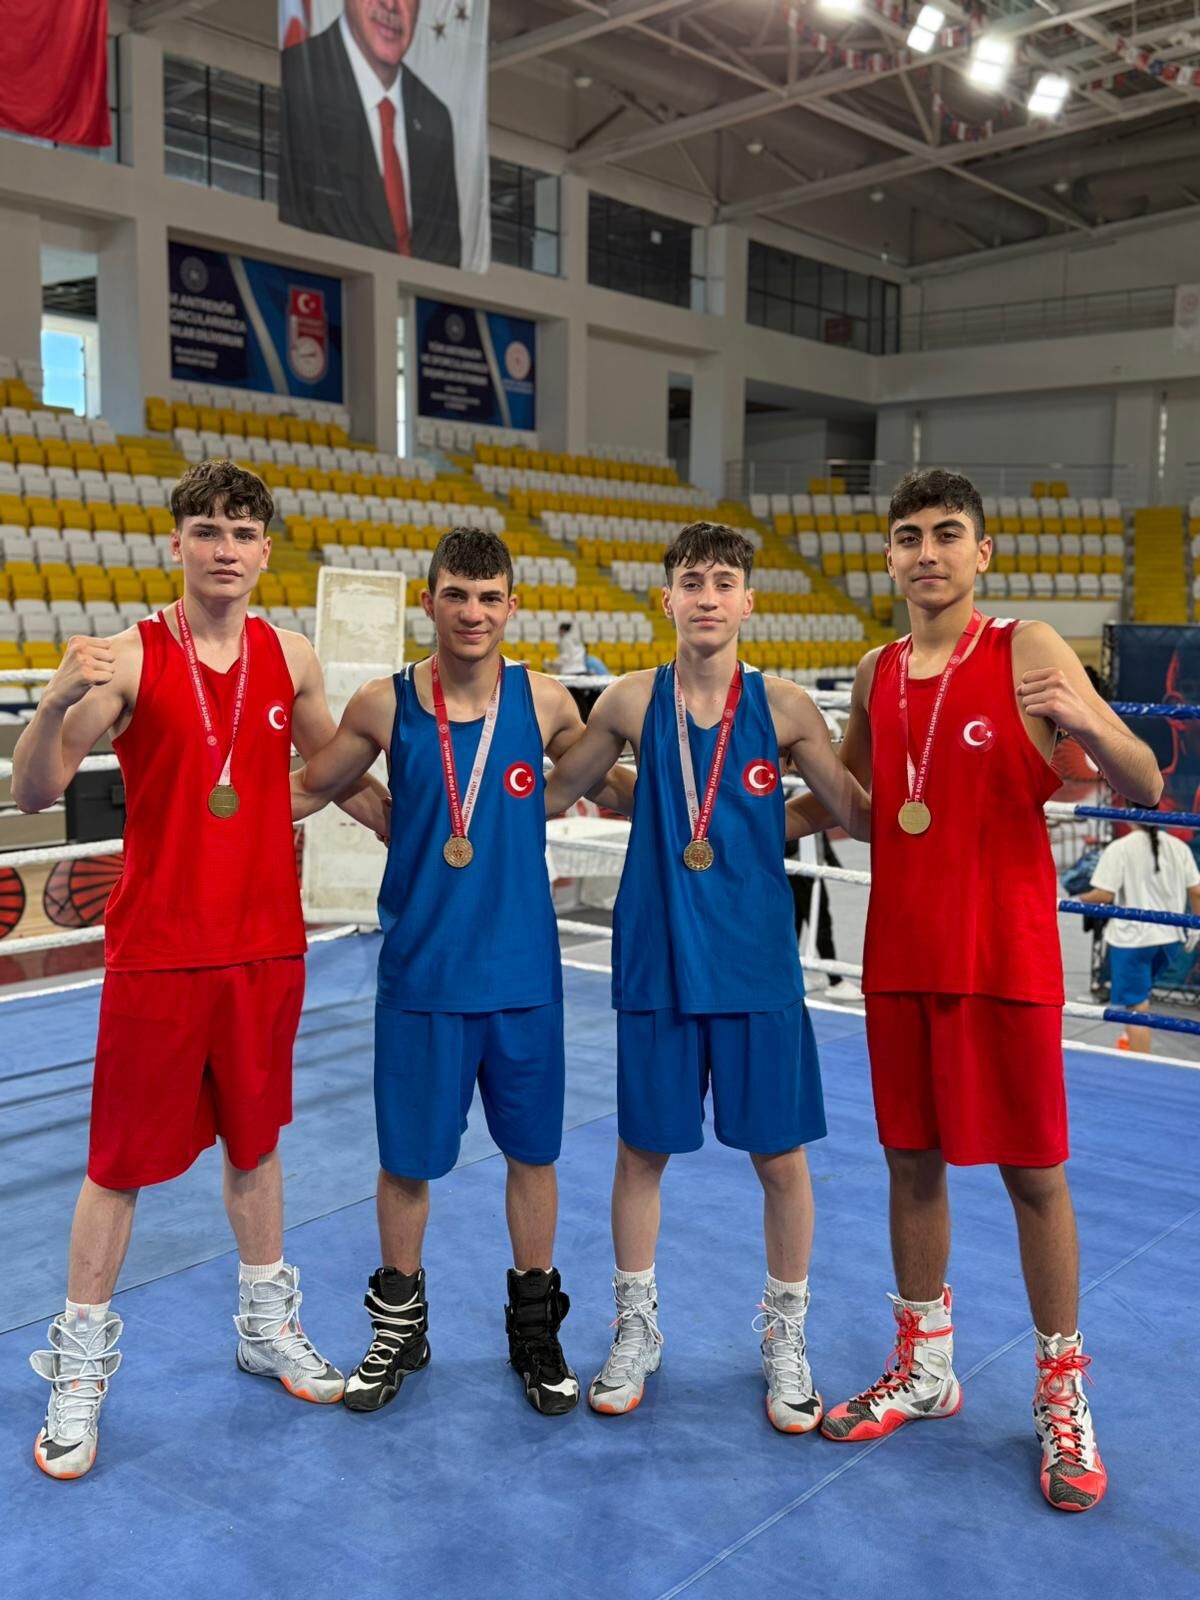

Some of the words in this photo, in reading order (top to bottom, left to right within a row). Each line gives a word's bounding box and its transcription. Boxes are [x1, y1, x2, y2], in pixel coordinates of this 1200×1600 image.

[920, 766, 926, 774] VE
[916, 776, 924, 793] SPOR
[450, 792, 456, 800] VE
[702, 815, 708, 823] VE
